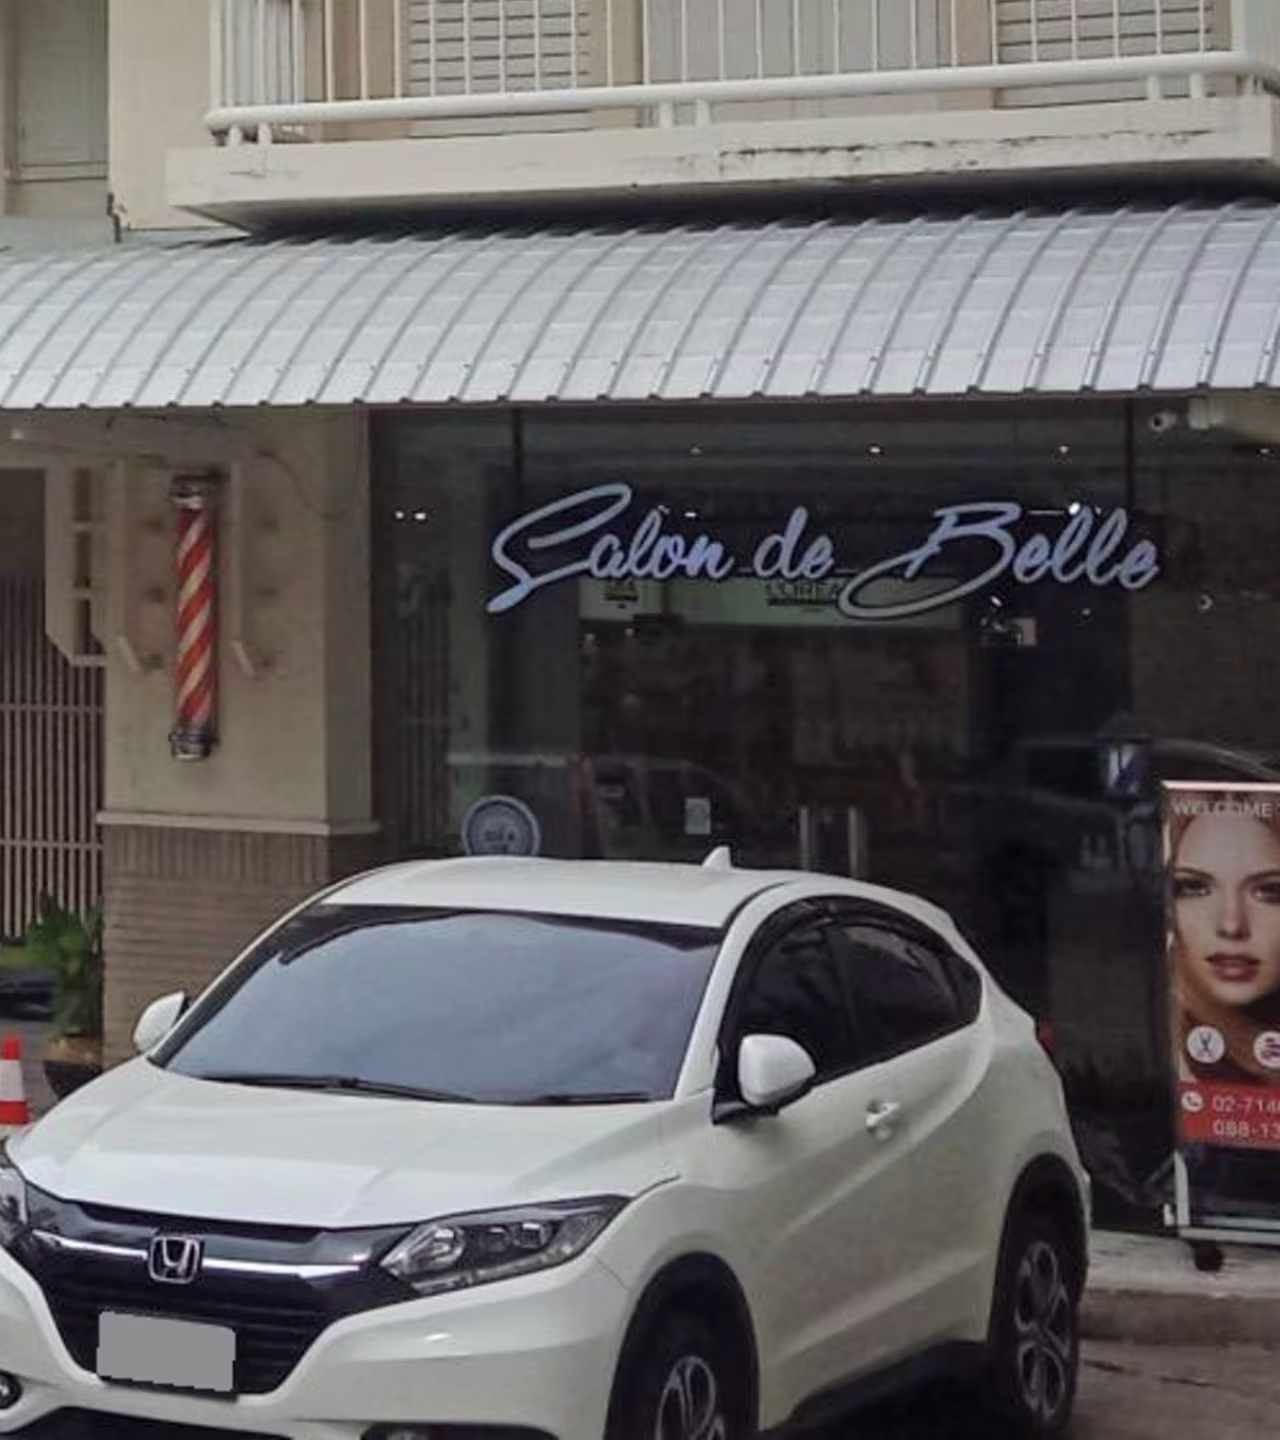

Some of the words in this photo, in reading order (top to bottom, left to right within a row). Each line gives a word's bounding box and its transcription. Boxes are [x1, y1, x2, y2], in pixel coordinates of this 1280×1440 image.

[486, 482, 734, 613] Salon
[752, 505, 836, 579] de
[839, 501, 1160, 619] Belle
